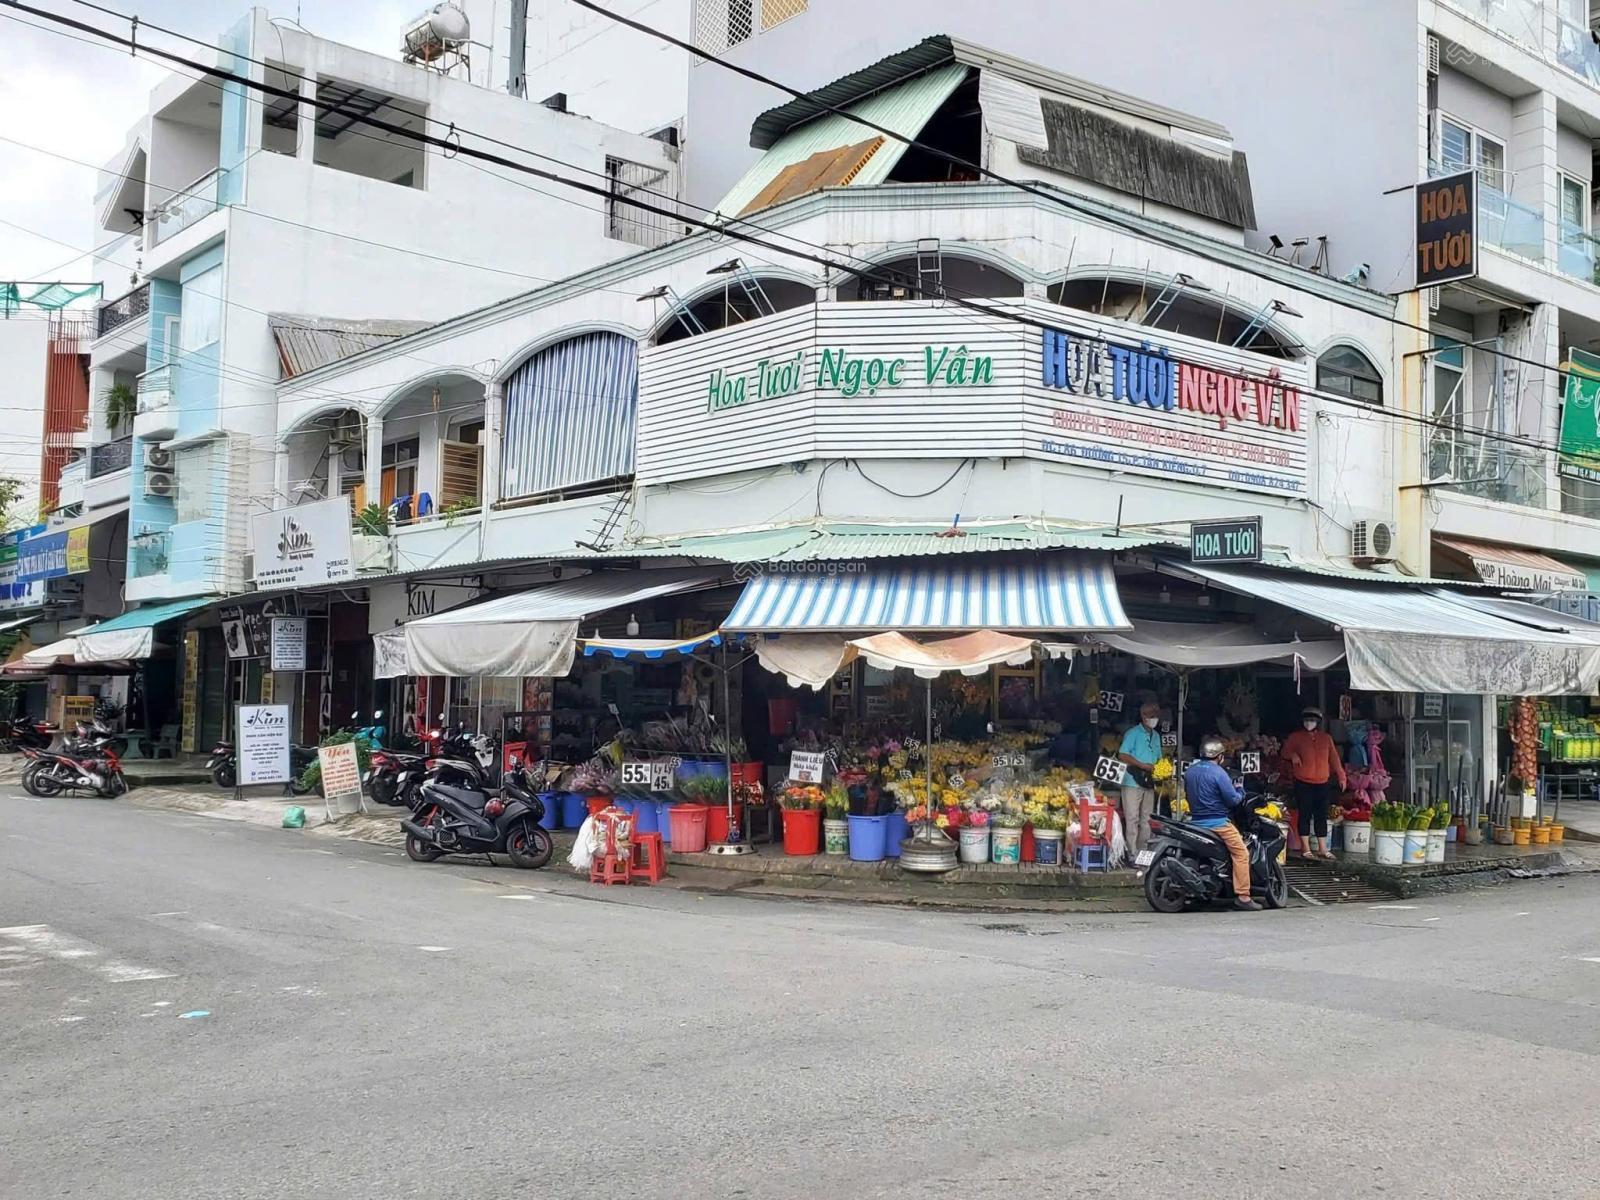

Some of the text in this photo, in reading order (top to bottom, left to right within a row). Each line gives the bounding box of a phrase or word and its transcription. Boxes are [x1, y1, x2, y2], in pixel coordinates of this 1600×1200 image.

[1422, 184, 1467, 223] HOA
[1419, 230, 1470, 273] TƯƠI
[707, 344, 993, 414] Hoa Tươi Ngọc Vân
[1042, 328, 1107, 397] HOA
[1108, 340, 1175, 410] TƯƠI
[1178, 361, 1250, 431] NGỌC
[1195, 528, 1254, 556] HOA TƯƠI
[1476, 563, 1495, 578] SHOP
[407, 589, 436, 616] KIM
[252, 708, 284, 727] Kim
